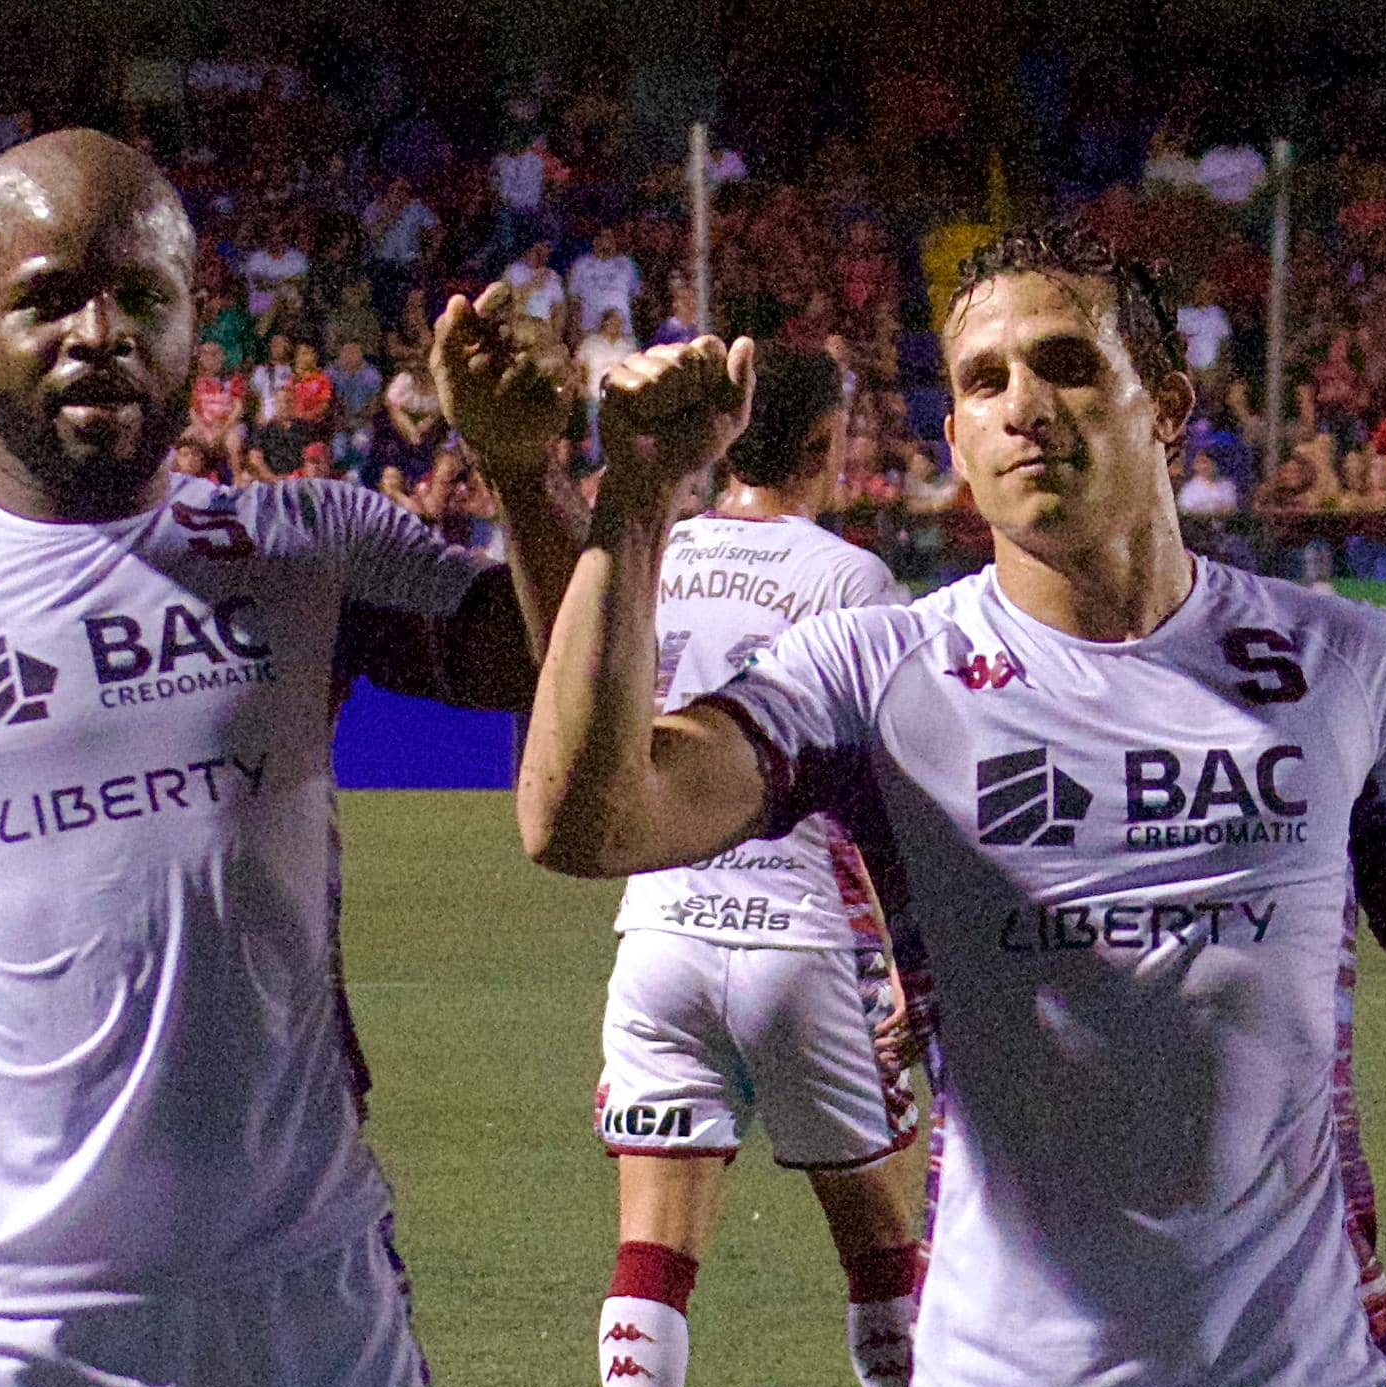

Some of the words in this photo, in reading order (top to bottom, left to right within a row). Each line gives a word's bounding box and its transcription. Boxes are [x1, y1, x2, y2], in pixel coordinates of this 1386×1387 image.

[172, 500, 256, 562] S
[676, 541, 792, 565] medismart
[85, 597, 273, 684] BAC
[100, 662, 278, 708] CREDOMATIC
[1223, 626, 1308, 705] S
[1125, 745, 1308, 823] BAC
[1125, 821, 1309, 849] CREDOMATIC
[713, 849, 806, 870] Pinos
[684, 895, 770, 915] STAR
[693, 911, 791, 931] CARS
[999, 899, 1277, 951] LIBERTY
